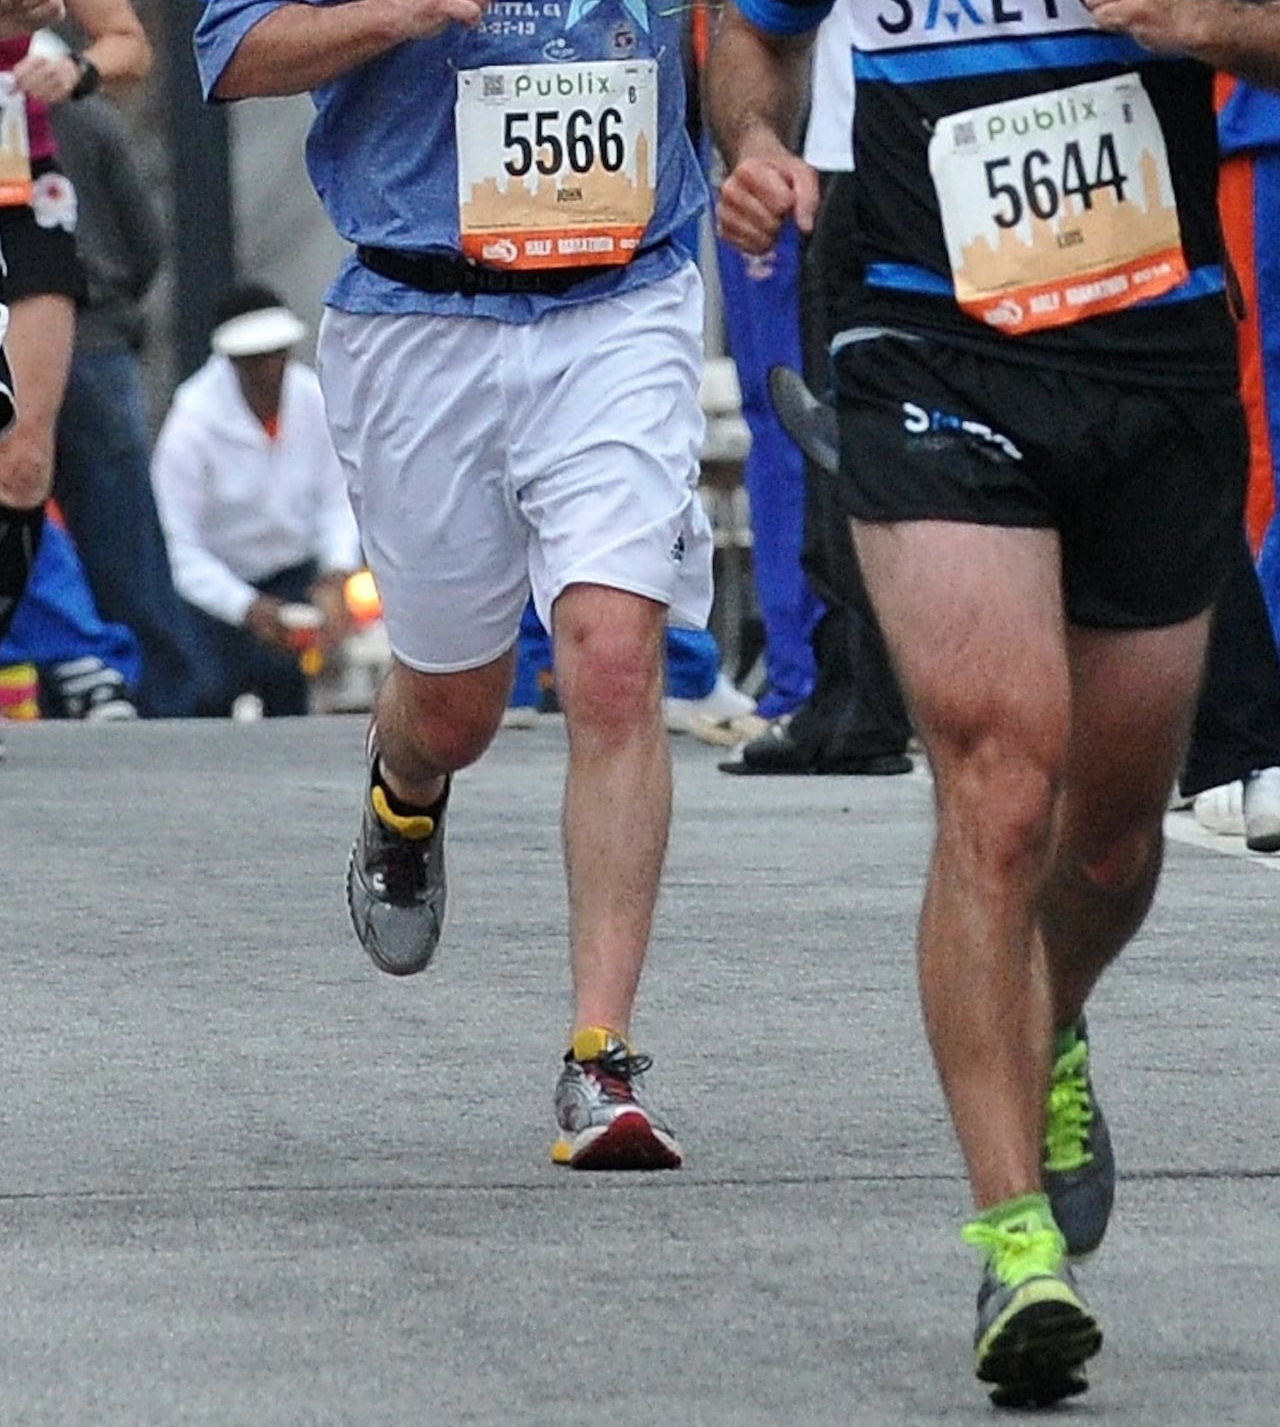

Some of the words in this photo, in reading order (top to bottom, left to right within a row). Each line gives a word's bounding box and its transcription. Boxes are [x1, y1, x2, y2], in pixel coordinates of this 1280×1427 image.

[515, 72, 610, 97] Publix
[503, 107, 625, 177] 5566
[987, 98, 1098, 141] Publix
[983, 132, 1128, 229] 5644
